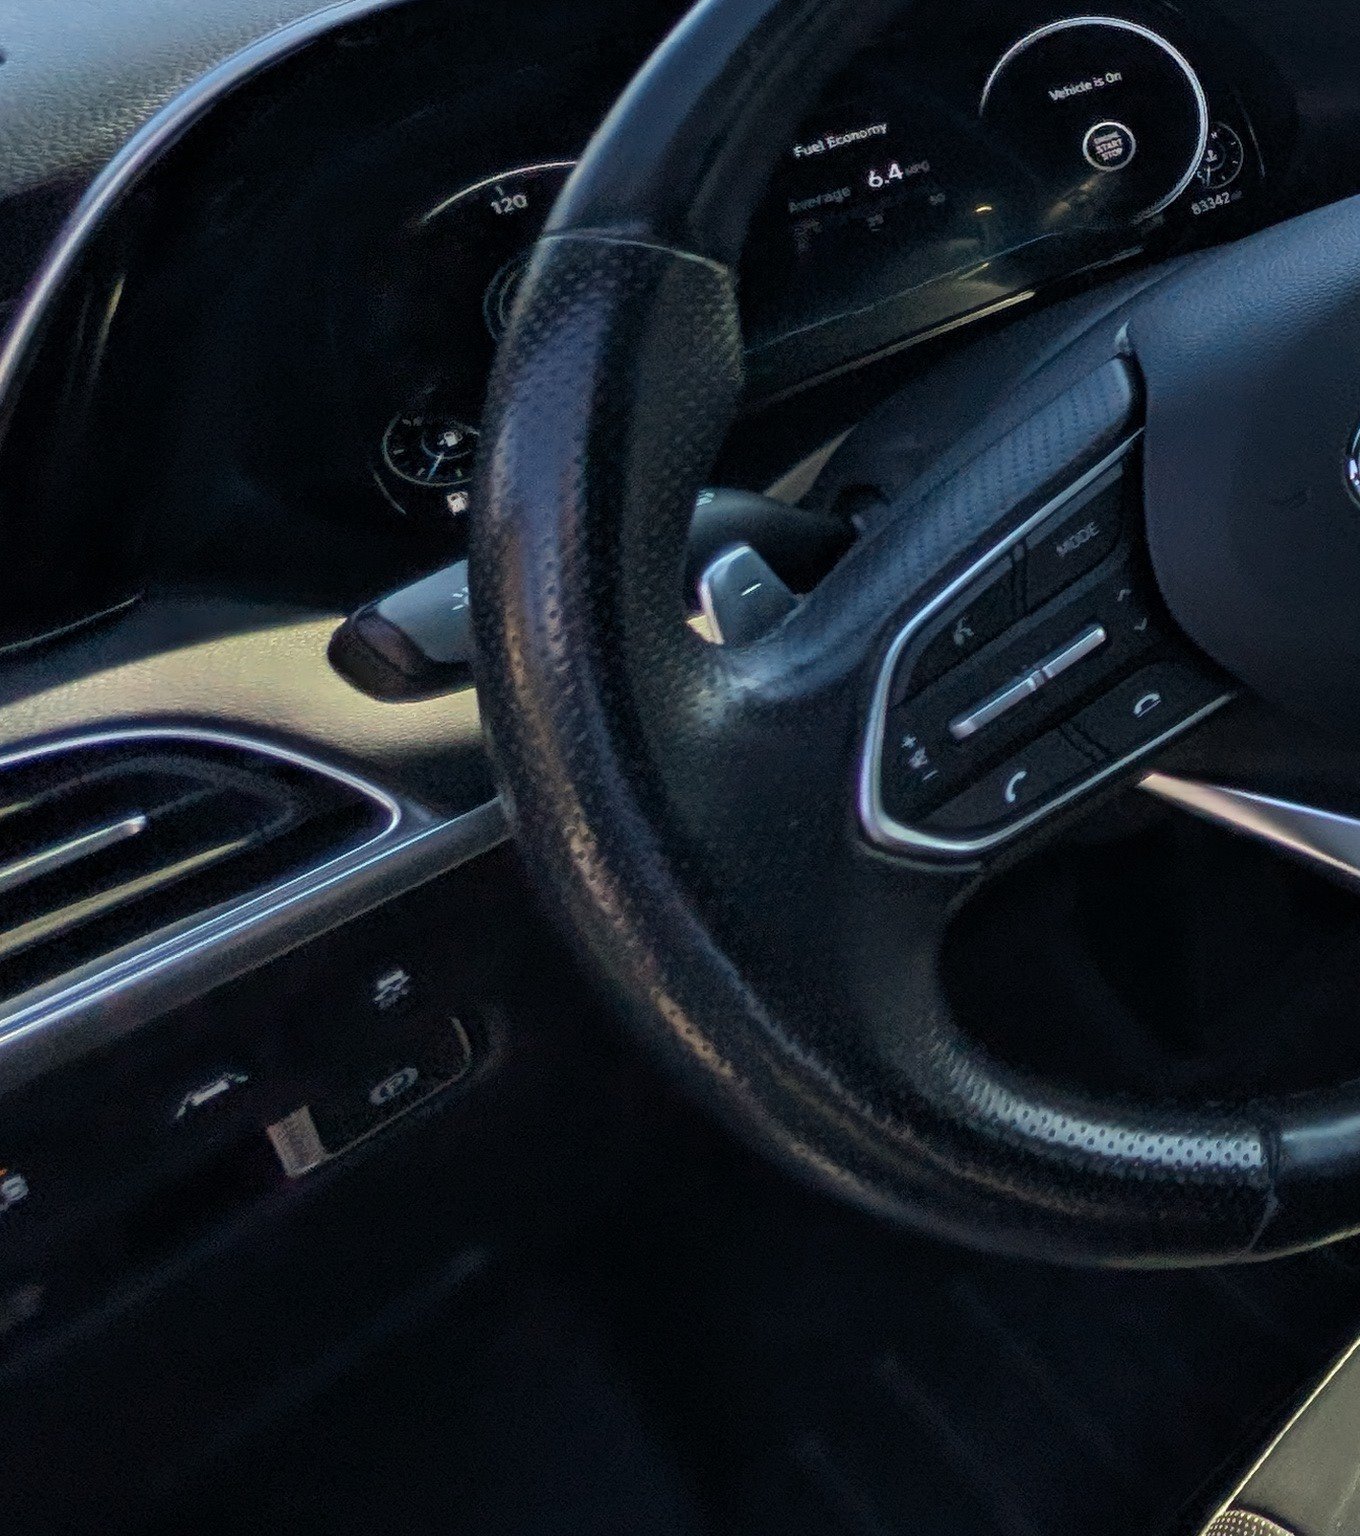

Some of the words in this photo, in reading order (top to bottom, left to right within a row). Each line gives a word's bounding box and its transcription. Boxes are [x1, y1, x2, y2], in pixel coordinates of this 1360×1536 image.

[1048, 81, 1093, 102] Vehicle
[1093, 77, 1105, 87] is
[1105, 71, 1122, 83] On
[793, 139, 826, 158] Fuel
[826, 123, 888, 149] Economy
[1095, 138, 1122, 154] START
[868, 163, 904, 188] 6.4
[491, 195, 527, 214] 120
[1190, 191, 1231, 215] 83342
[1056, 521, 1100, 557] MODE
